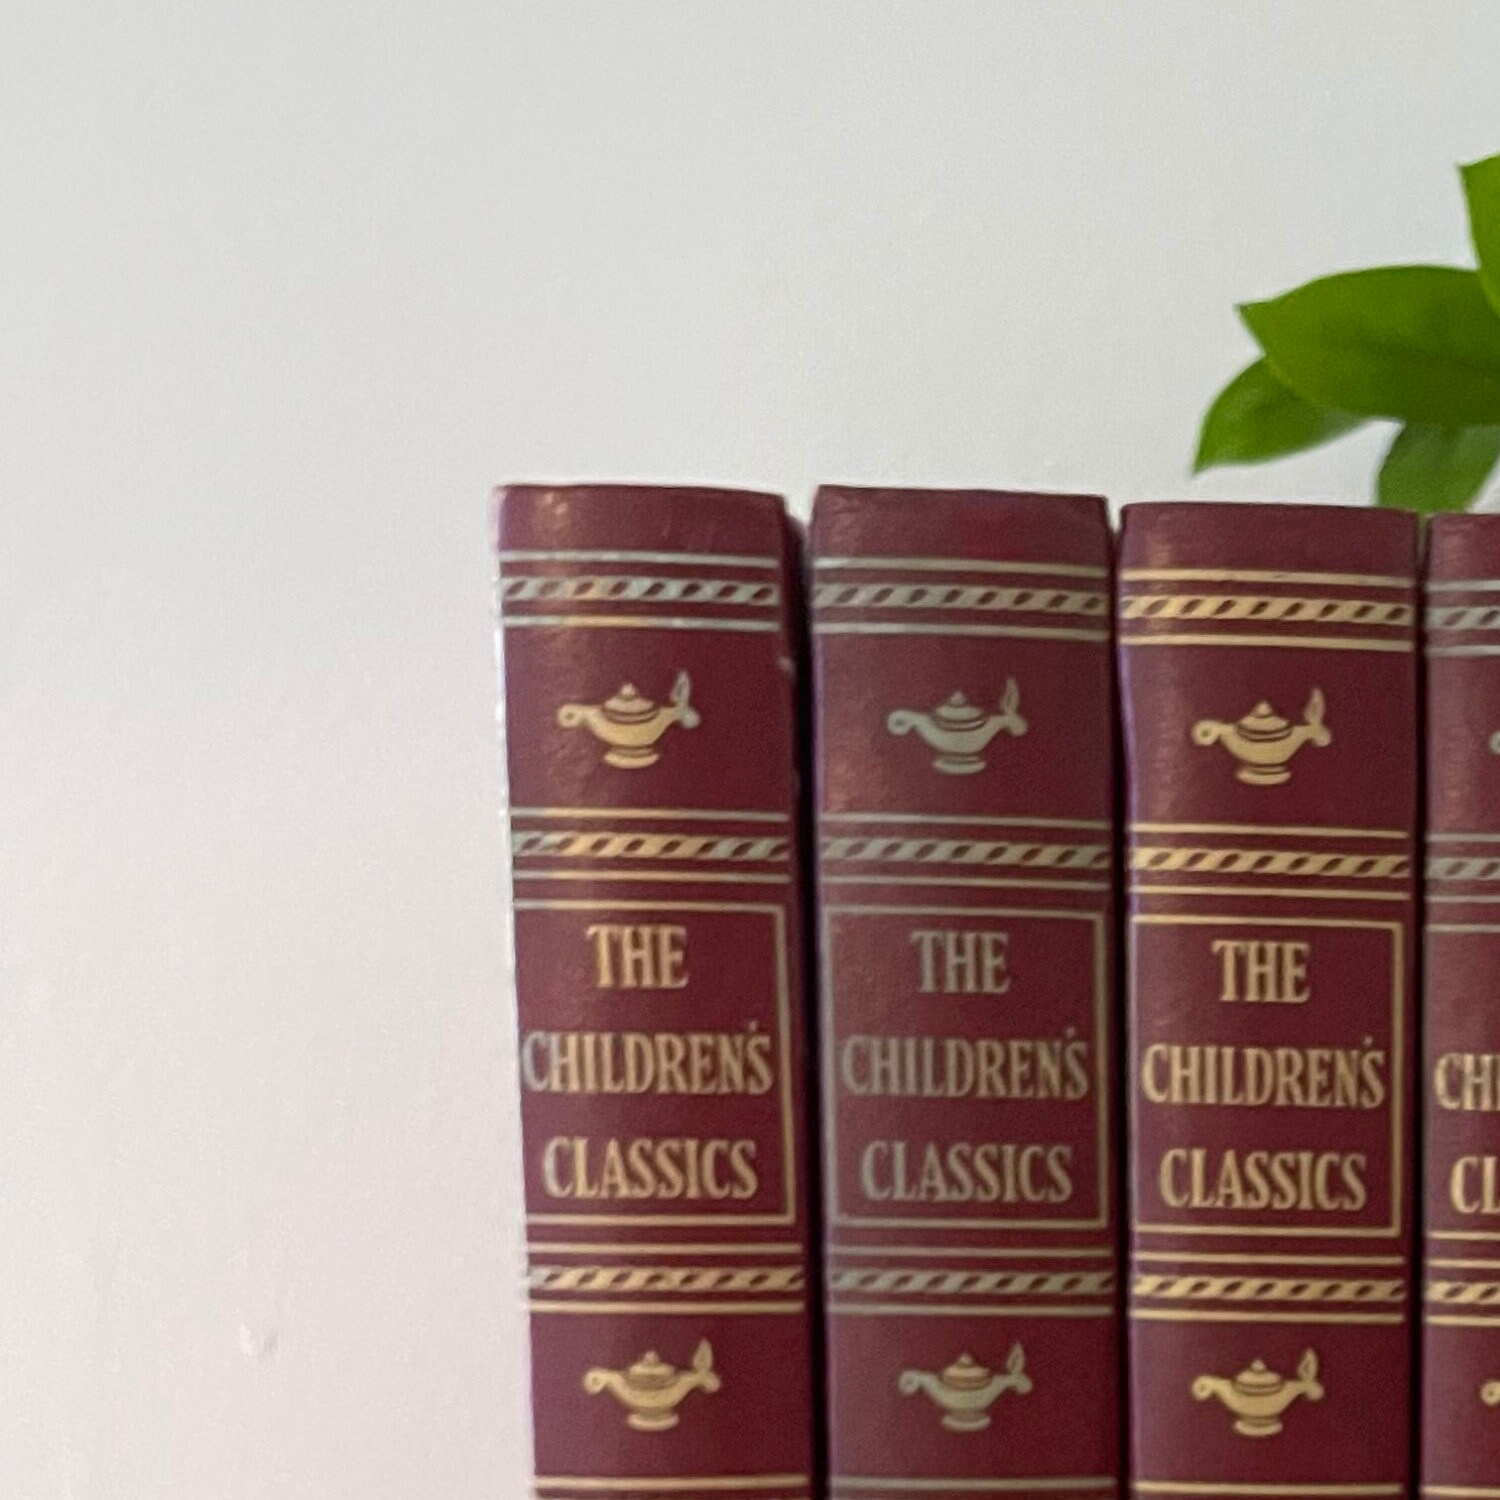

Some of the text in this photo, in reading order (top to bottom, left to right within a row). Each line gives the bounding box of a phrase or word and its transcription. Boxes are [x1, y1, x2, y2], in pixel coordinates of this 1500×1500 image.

[587, 924, 689, 990] THE
[911, 930, 1010, 995] THE
[1212, 940, 1310, 1003] THE
[521, 1020, 773, 1096] CHILDREN'S
[841, 1026, 1090, 1100] CHILDREN'S
[1141, 1035, 1386, 1109] CHILDREN'S
[543, 1136, 758, 1200] CLASSICS
[860, 1140, 1074, 1203] CLASSICS
[1159, 1148, 1367, 1212] CLASSICS
